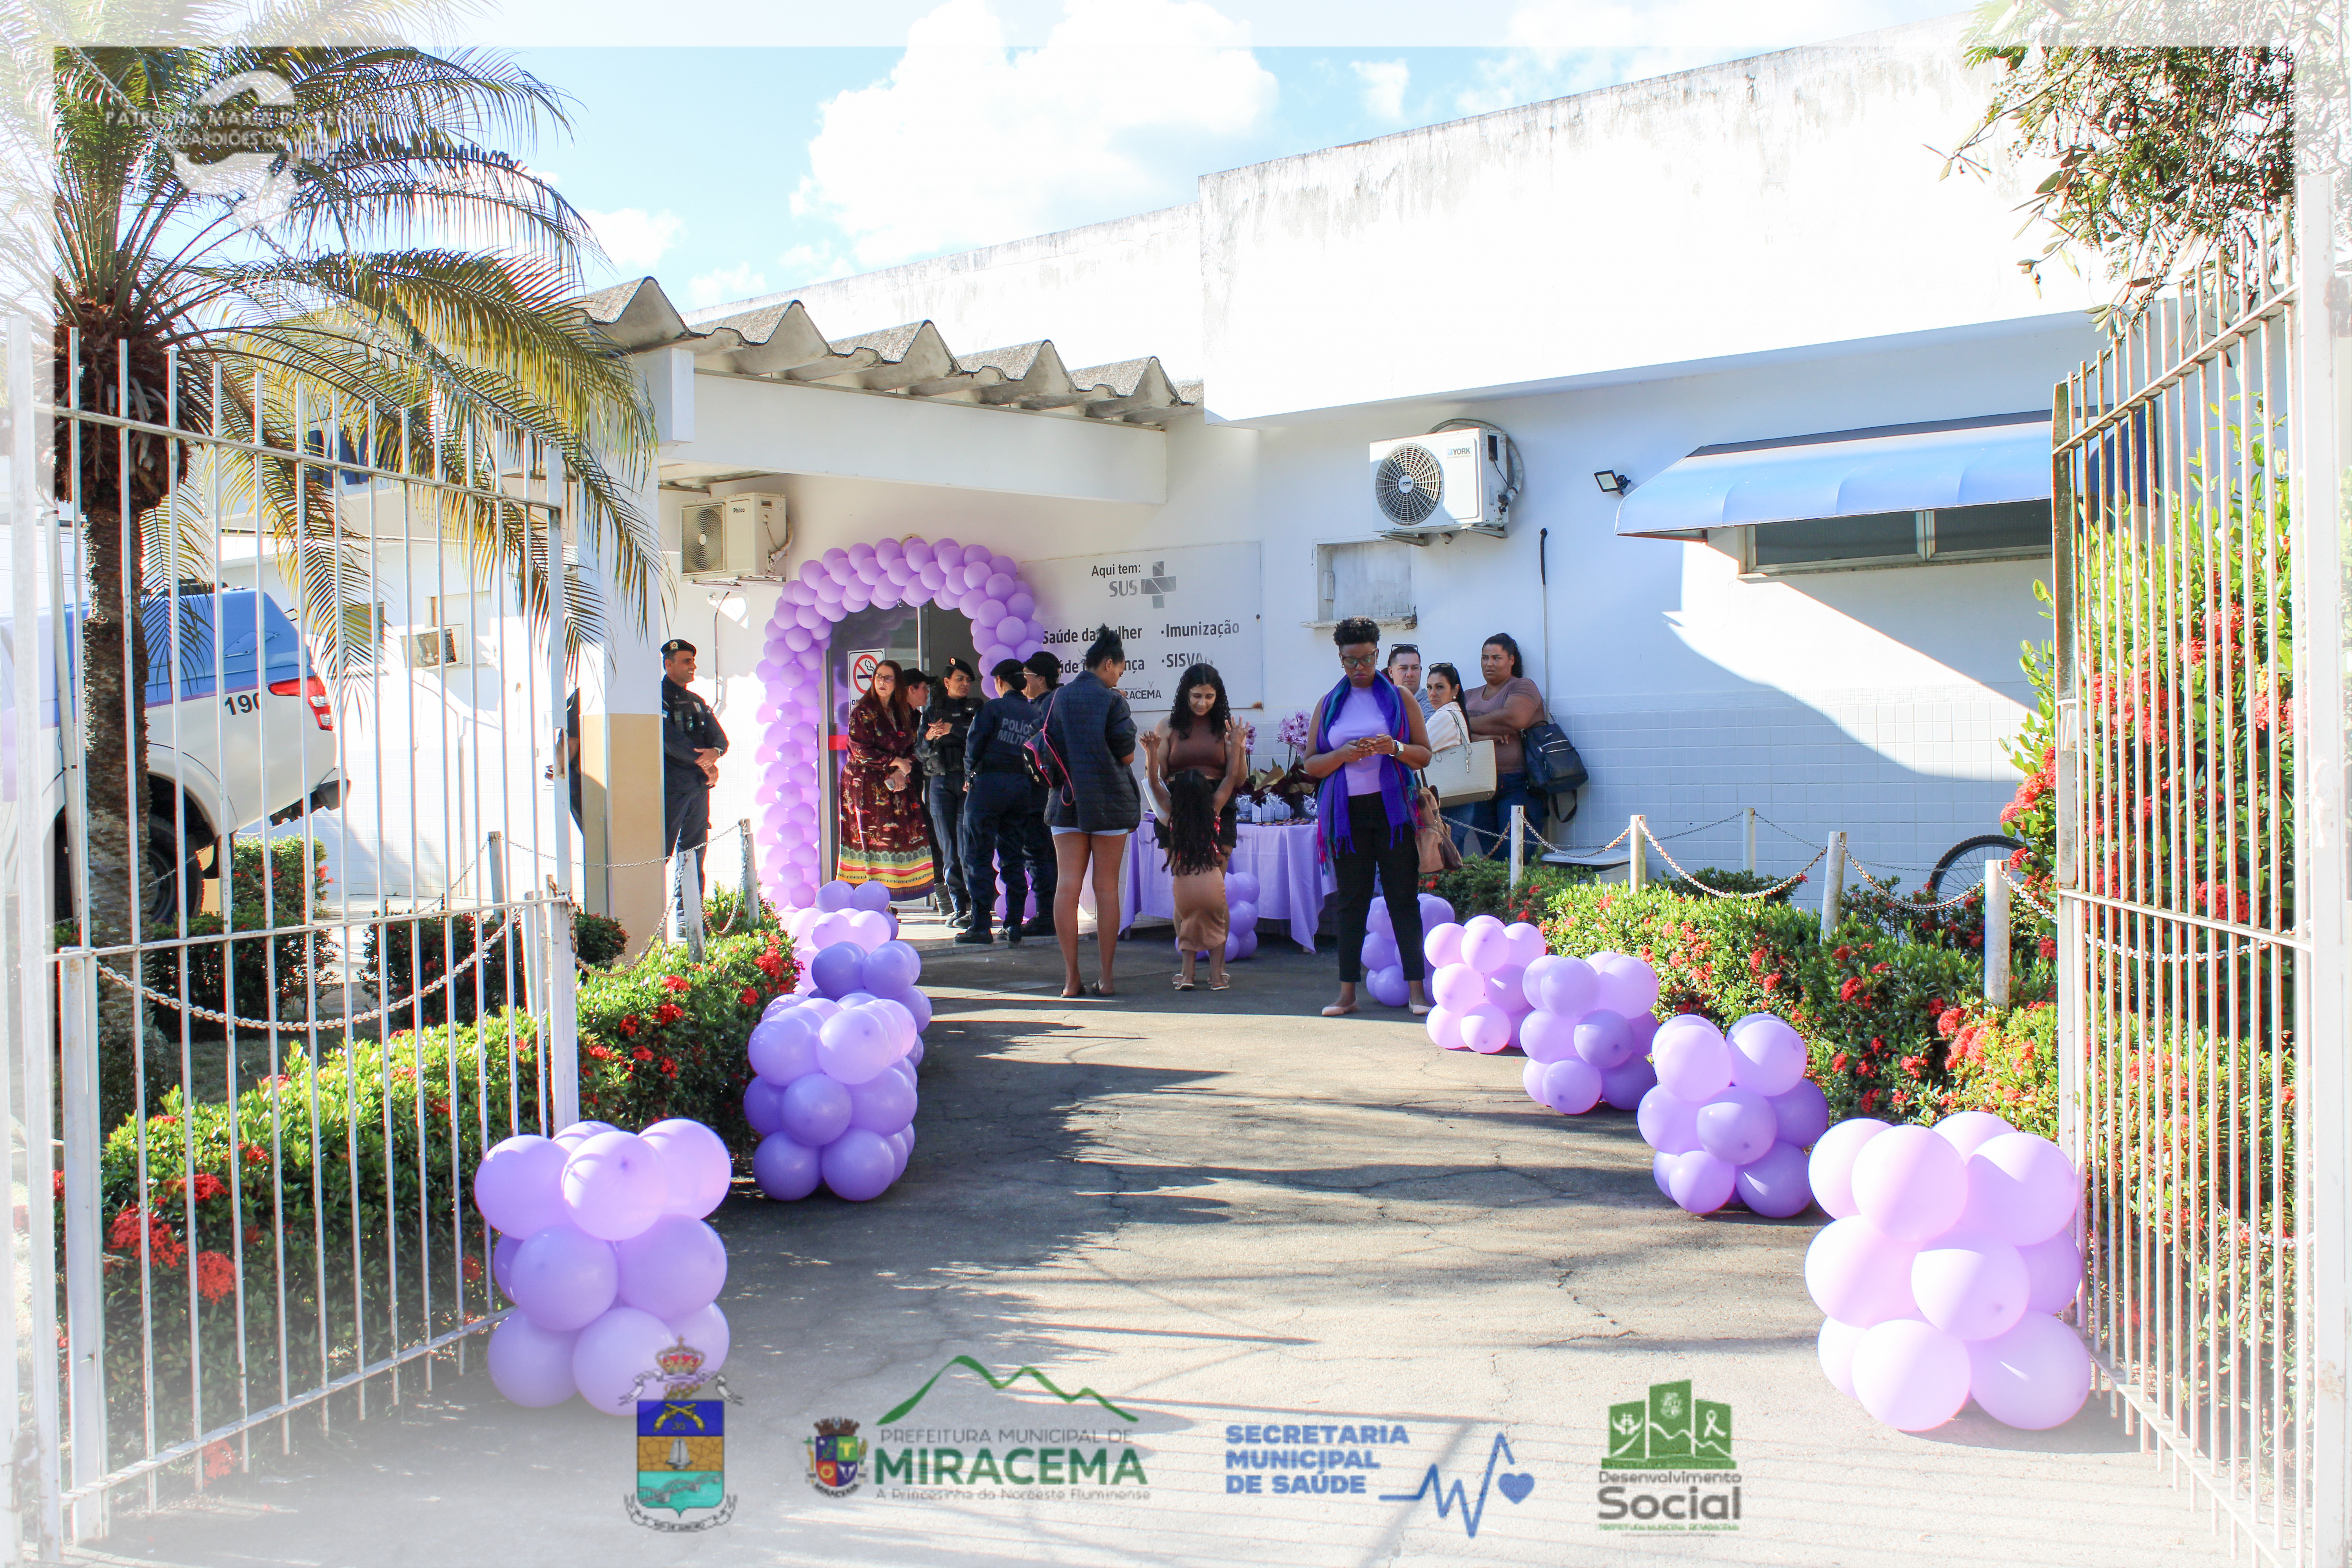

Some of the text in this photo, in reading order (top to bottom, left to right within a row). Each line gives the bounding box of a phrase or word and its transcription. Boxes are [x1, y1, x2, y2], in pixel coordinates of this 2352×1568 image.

[1091, 564, 1141, 579] Aqui tem:
[1109, 579, 1138, 597] SUS
[1042, 629, 1078, 644] Saúde
[1082, 628, 1096, 642] da
[1001, 718, 1029, 735] POLÍC
